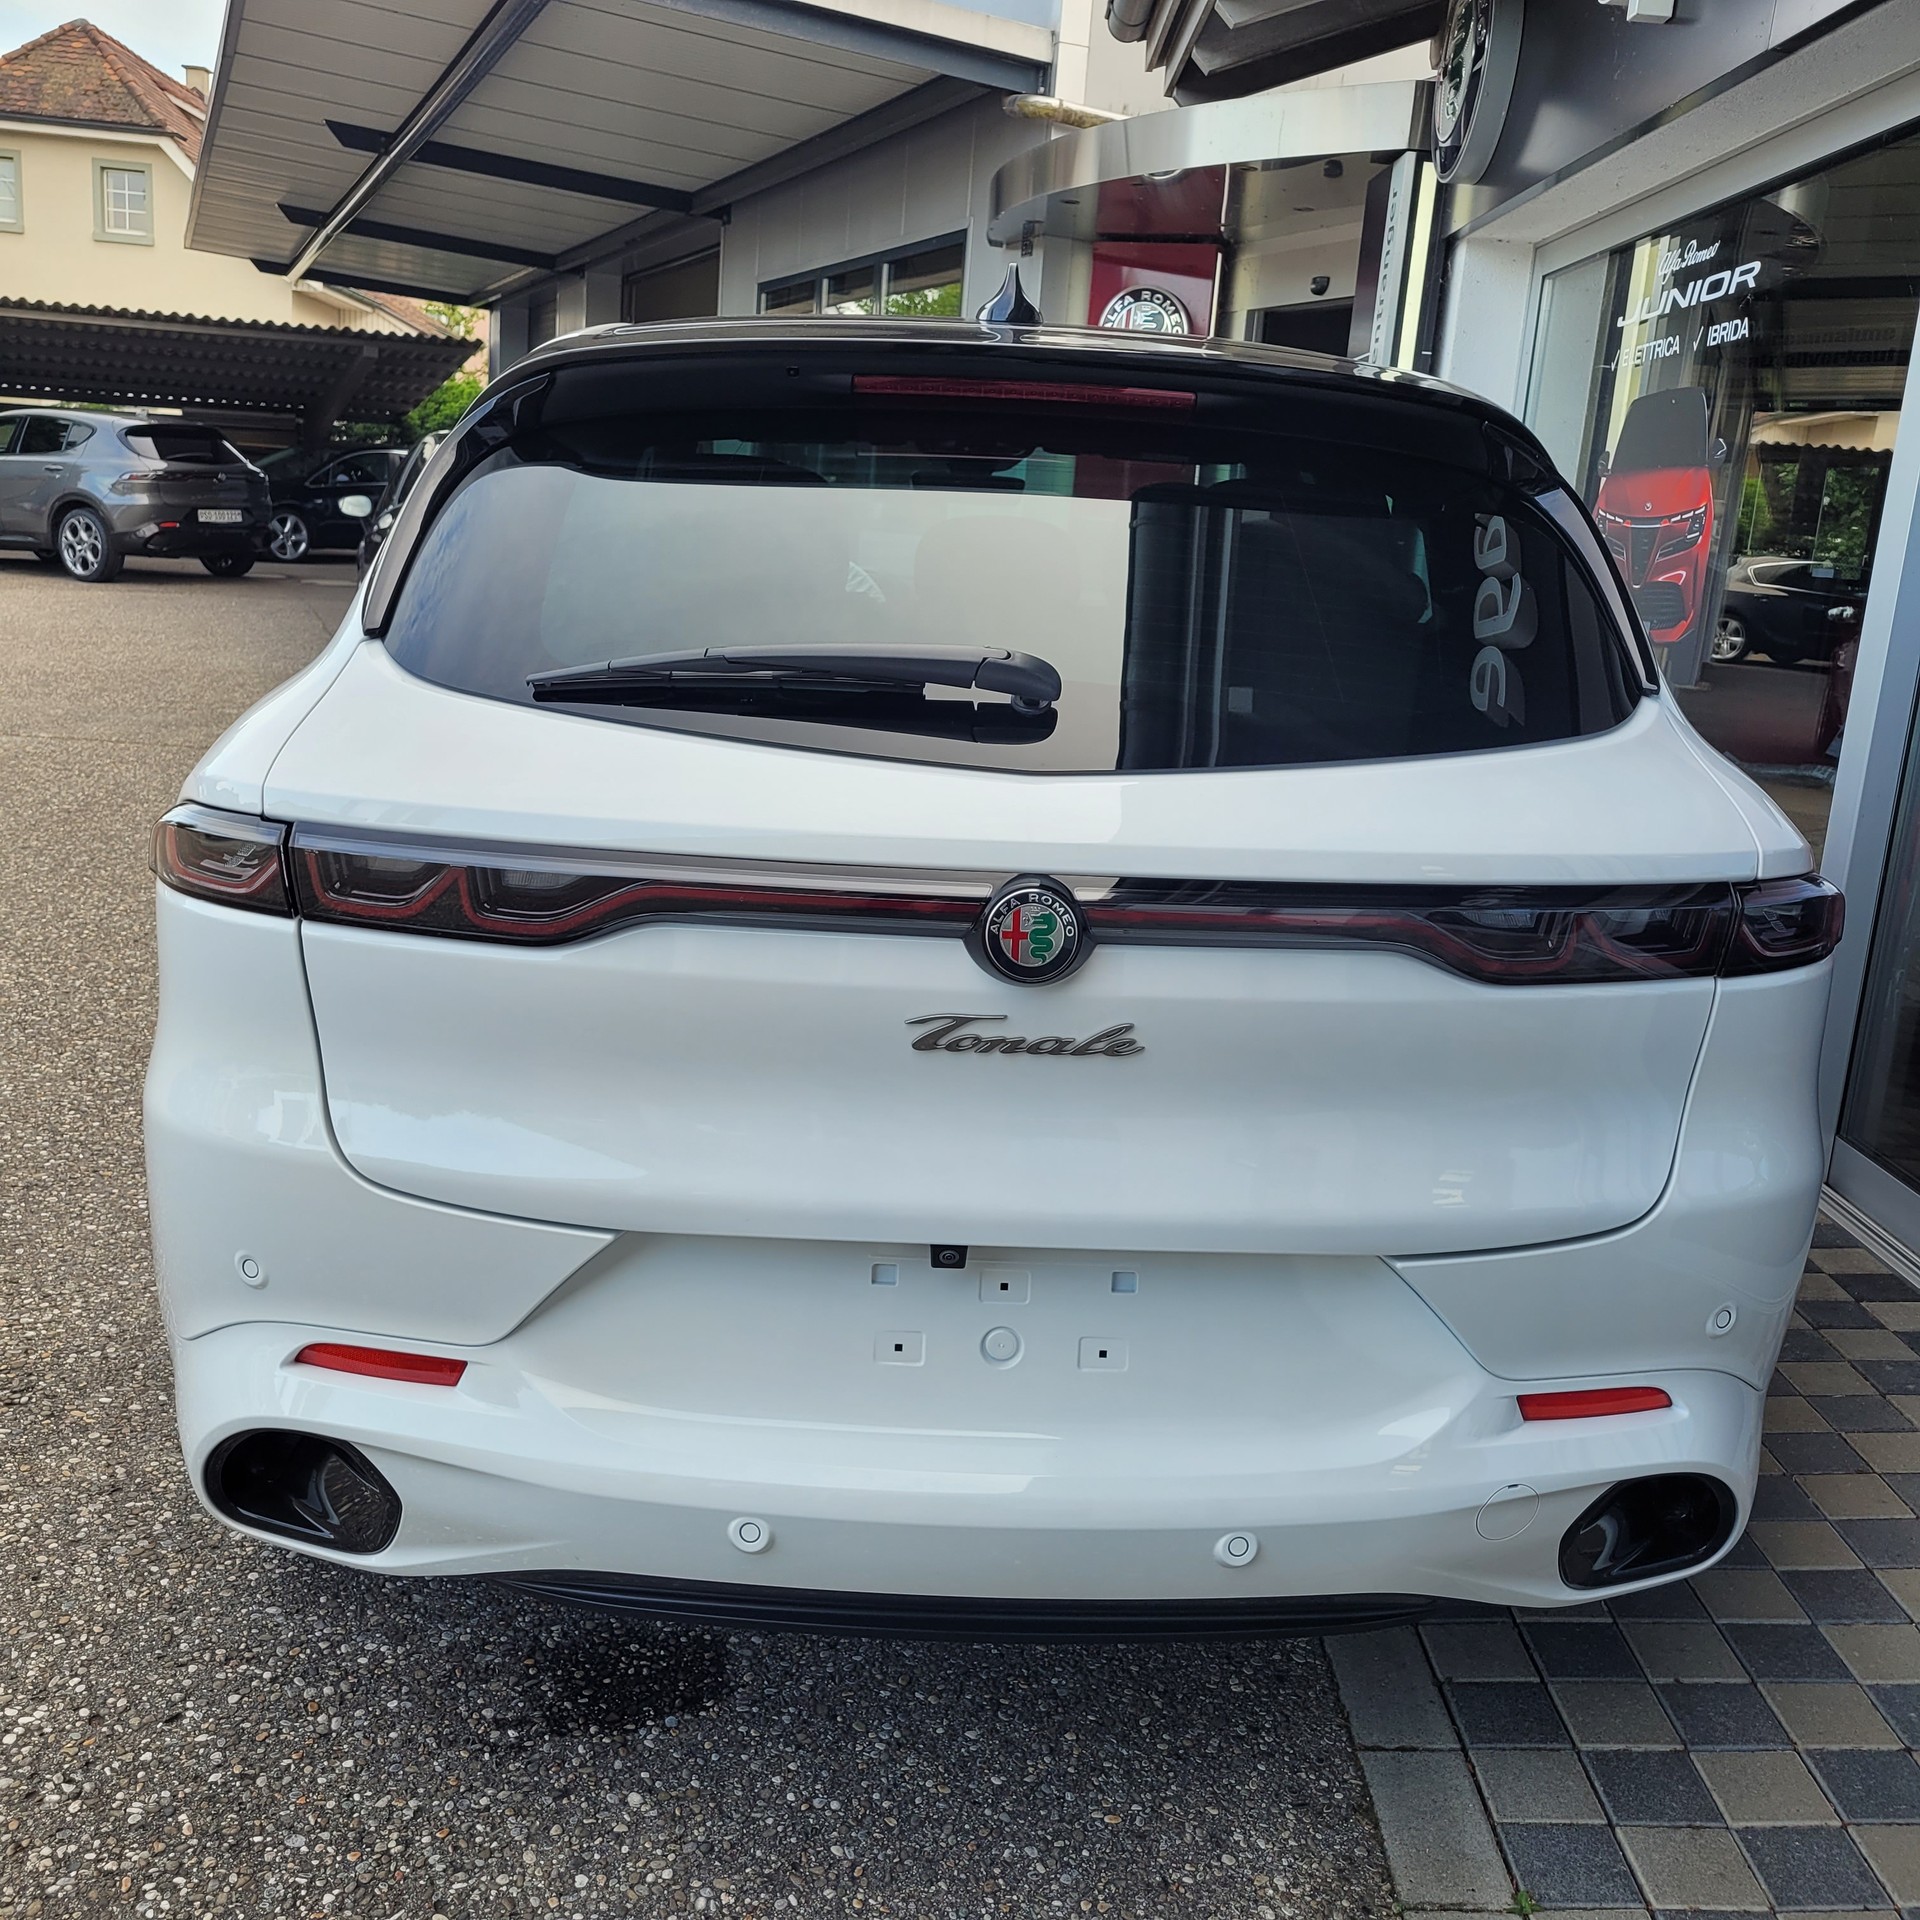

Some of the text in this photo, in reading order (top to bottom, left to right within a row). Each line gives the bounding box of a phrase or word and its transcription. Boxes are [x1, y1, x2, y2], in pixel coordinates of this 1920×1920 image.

[1658, 239, 1721, 285] Alfa Romeo
[1141, 291, 1183, 334] ROMEO
[1617, 260, 1762, 328] JUNIOR
[1621, 335, 1680, 367] ELETTRICA
[1706, 317, 1749, 347] IBRIDA
[990, 893, 1075, 937] ALFA ROMEO
[904, 1013, 1146, 1057] Tonale
